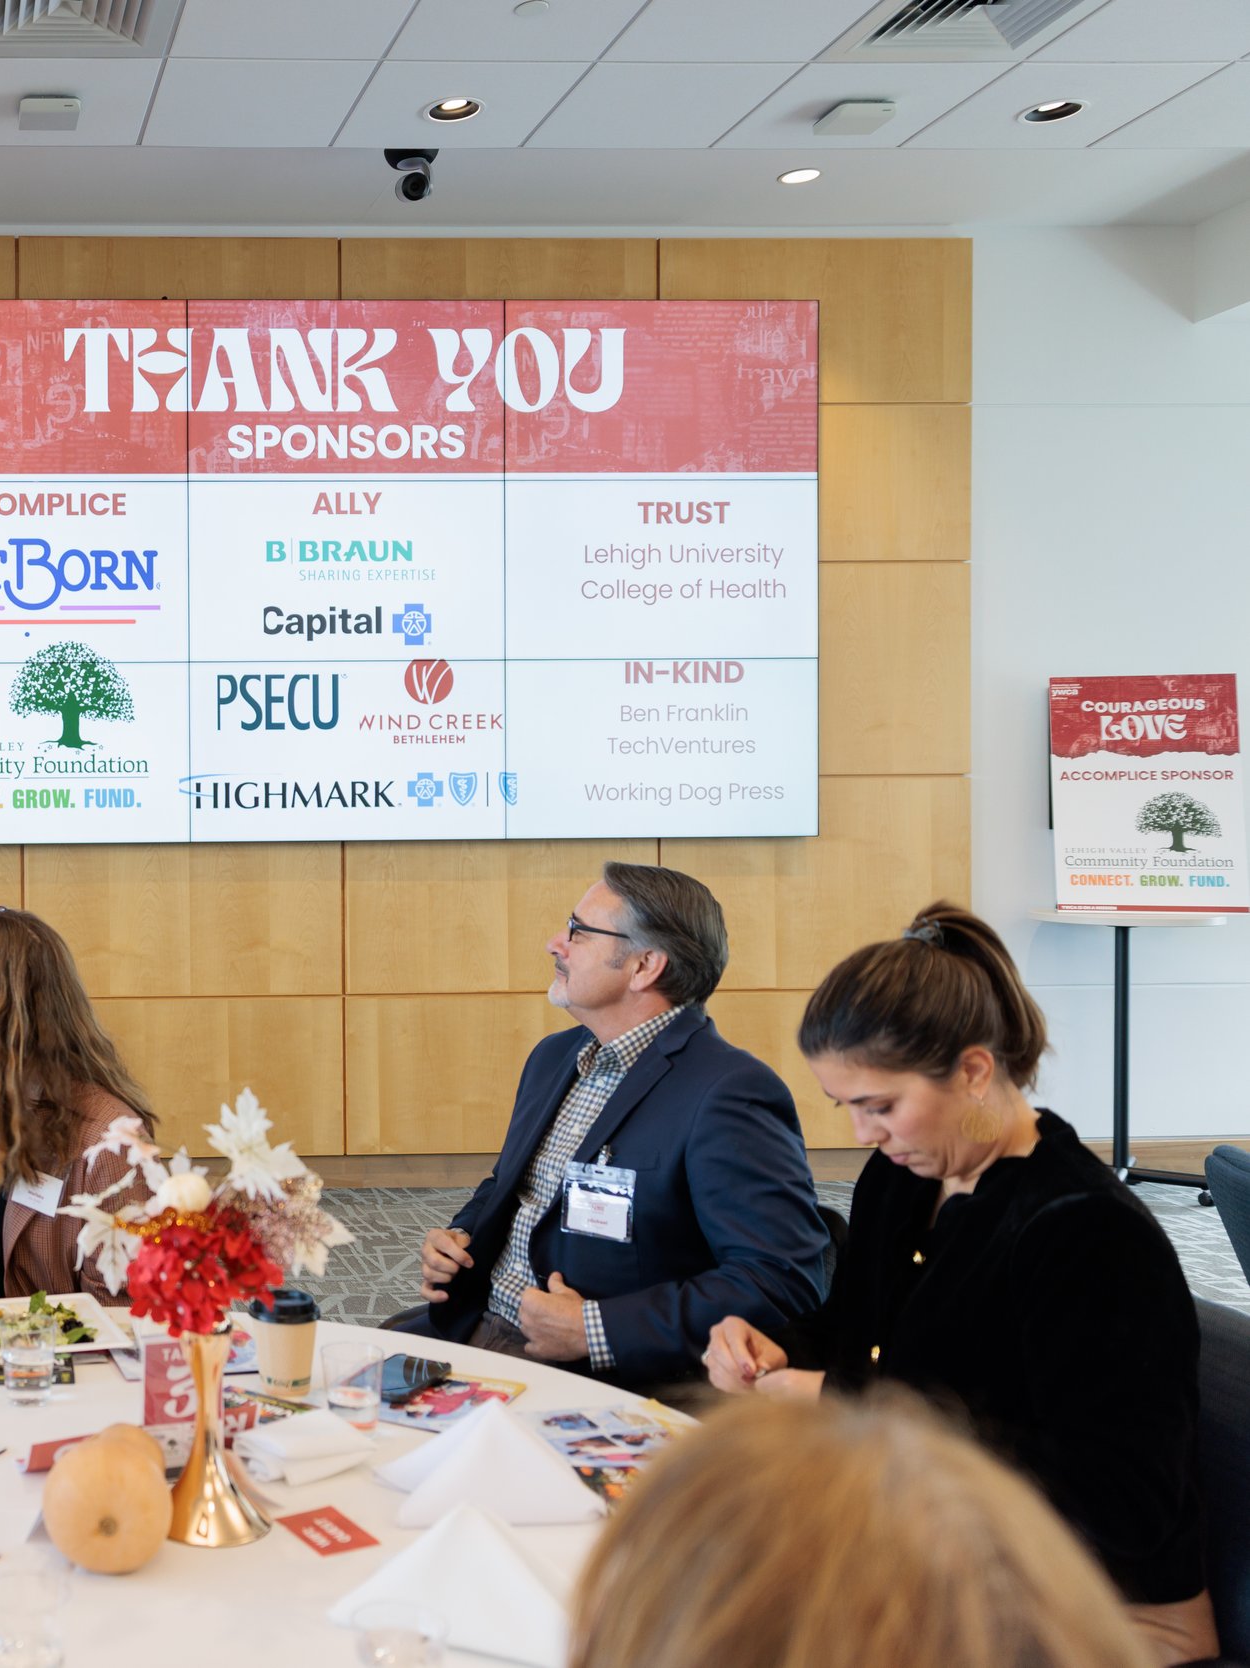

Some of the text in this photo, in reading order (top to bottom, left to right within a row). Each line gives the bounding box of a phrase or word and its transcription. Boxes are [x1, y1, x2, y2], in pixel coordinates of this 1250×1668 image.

[63, 326, 627, 413] THANK YOU
[227, 424, 466, 460] SPONSORS
[312, 492, 382, 515] ALLY
[637, 501, 731, 524] TRUST
[298, 540, 413, 562] BRAUN
[584, 542, 784, 570] Lehigh University
[299, 568, 436, 582] SHARING EXPERTISE
[581, 578, 787, 605] College of Health
[263, 605, 382, 642] Capital
[624, 661, 745, 684] IN-KIND
[216, 673, 340, 731] PSECU
[619, 703, 749, 722] Ben Franklin
[1081, 698, 1206, 713] COURAGEOUS
[359, 713, 504, 730] WIND CREEK
[1100, 714, 1188, 741] LOVE
[393, 735, 466, 744] BETHLEHEM
[607, 736, 756, 754] TechVentures
[33, 754, 149, 774] Foundation
[1060, 770, 1234, 781] ACCOMPLICE SPONSOR
[12, 788, 76, 809] GROW.
[84, 788, 142, 808] FUND.
[195, 780, 397, 809] HIGHMARK
[584, 782, 785, 806] Working Dog Press
[1064, 855, 1234, 869] Community Foundation
[1070, 874, 1230, 887] CONNECT. GROW. FUND.
